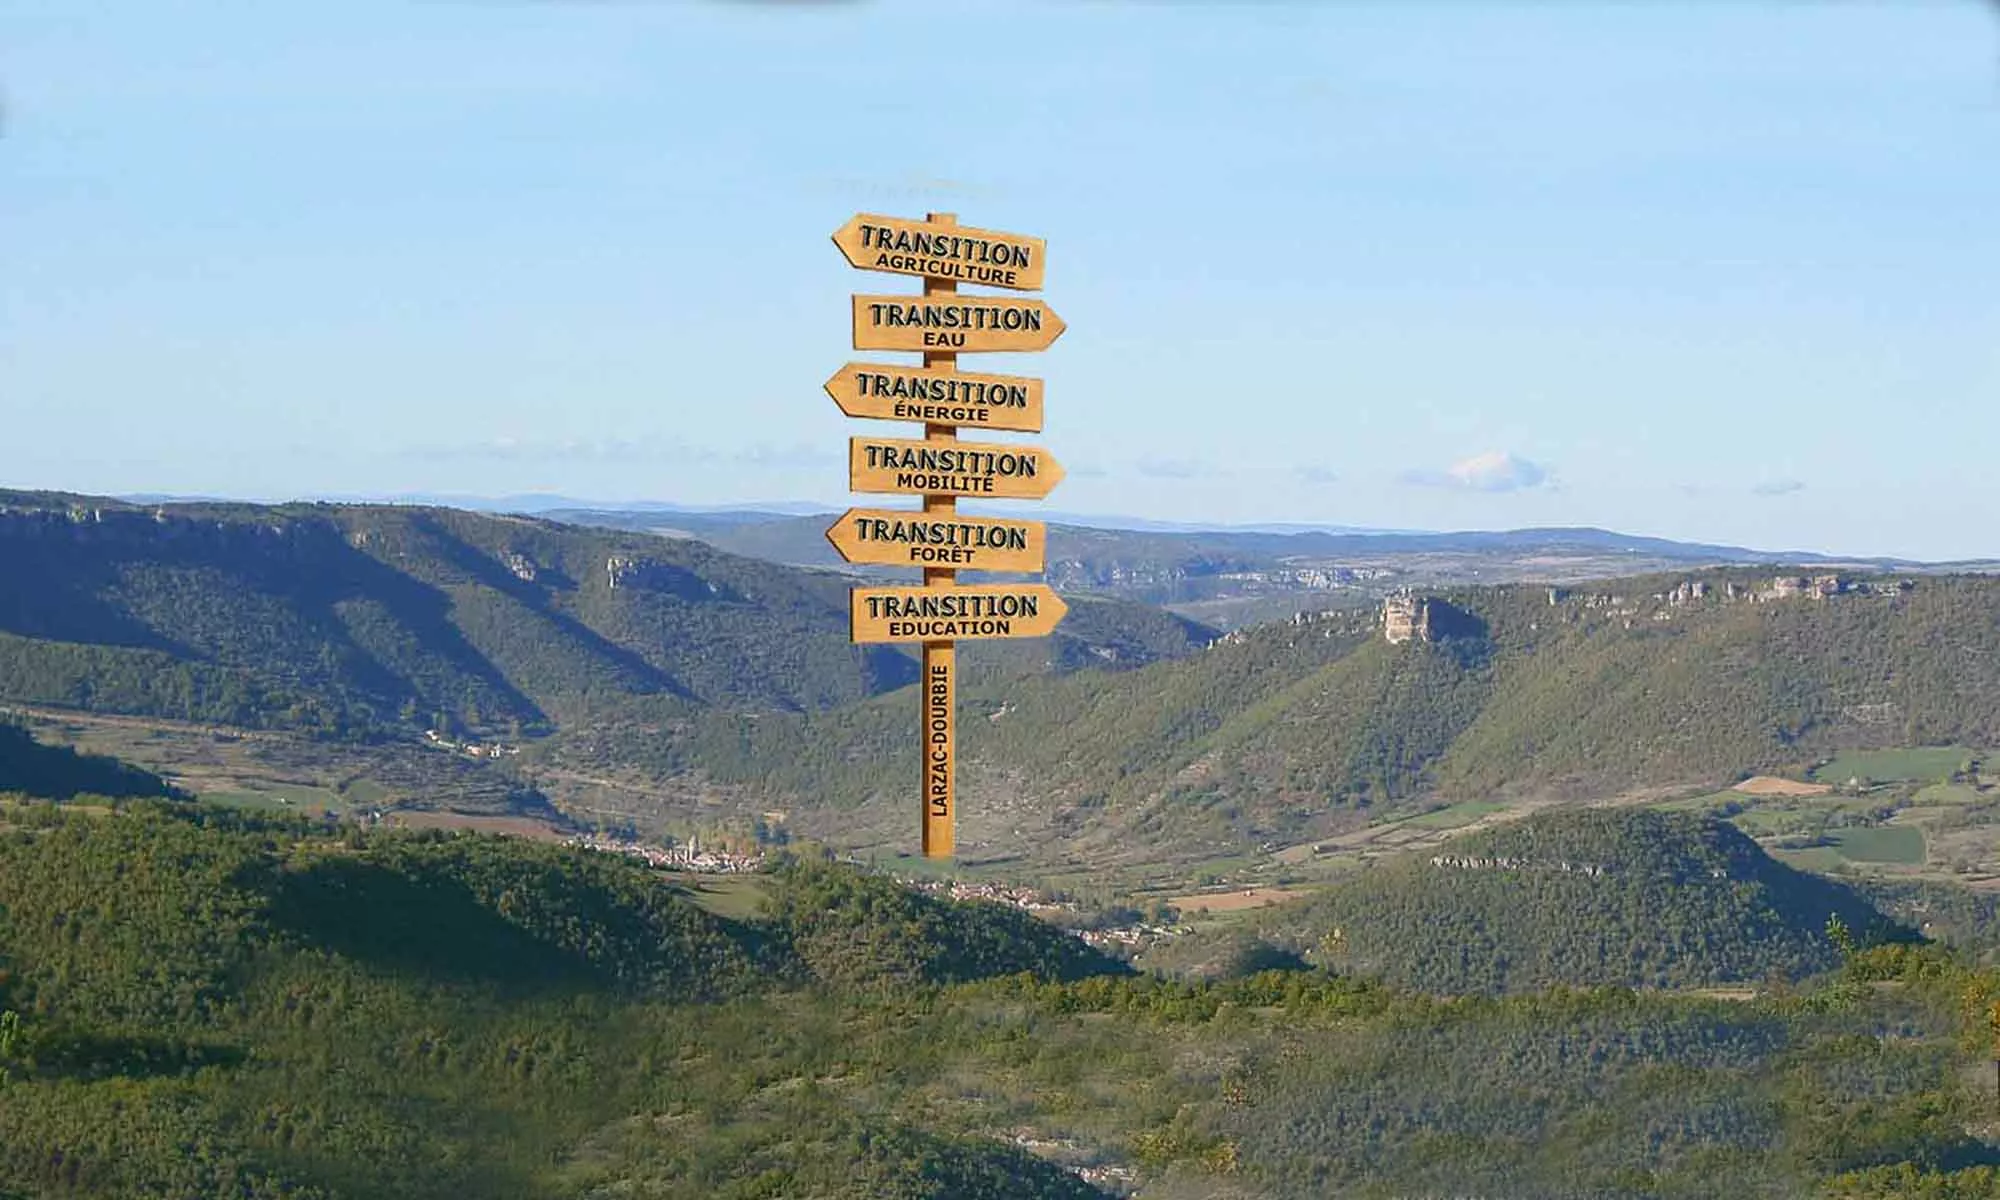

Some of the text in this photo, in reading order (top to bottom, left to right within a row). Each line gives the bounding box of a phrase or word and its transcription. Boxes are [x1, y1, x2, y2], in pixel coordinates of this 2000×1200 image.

[859, 225, 1030, 267] TRANSITION
[876, 253, 1016, 284] AGRICULTURE
[870, 304, 1041, 331] TRANSITION
[923, 332, 965, 347] EAU
[856, 373, 1027, 407] TRANSITION
[894, 401, 989, 421] ÉNERGIE
[865, 445, 1036, 477] TRANSITION
[897, 473, 993, 492] MOBILITÉ
[856, 518, 1027, 549] TRANSITION
[910, 546, 975, 563] FORÊT
[865, 595, 1038, 619] TRANSITION
[889, 621, 1010, 636] EDUCATION
[931, 665, 948, 817] LARZAC-DOURBIE
